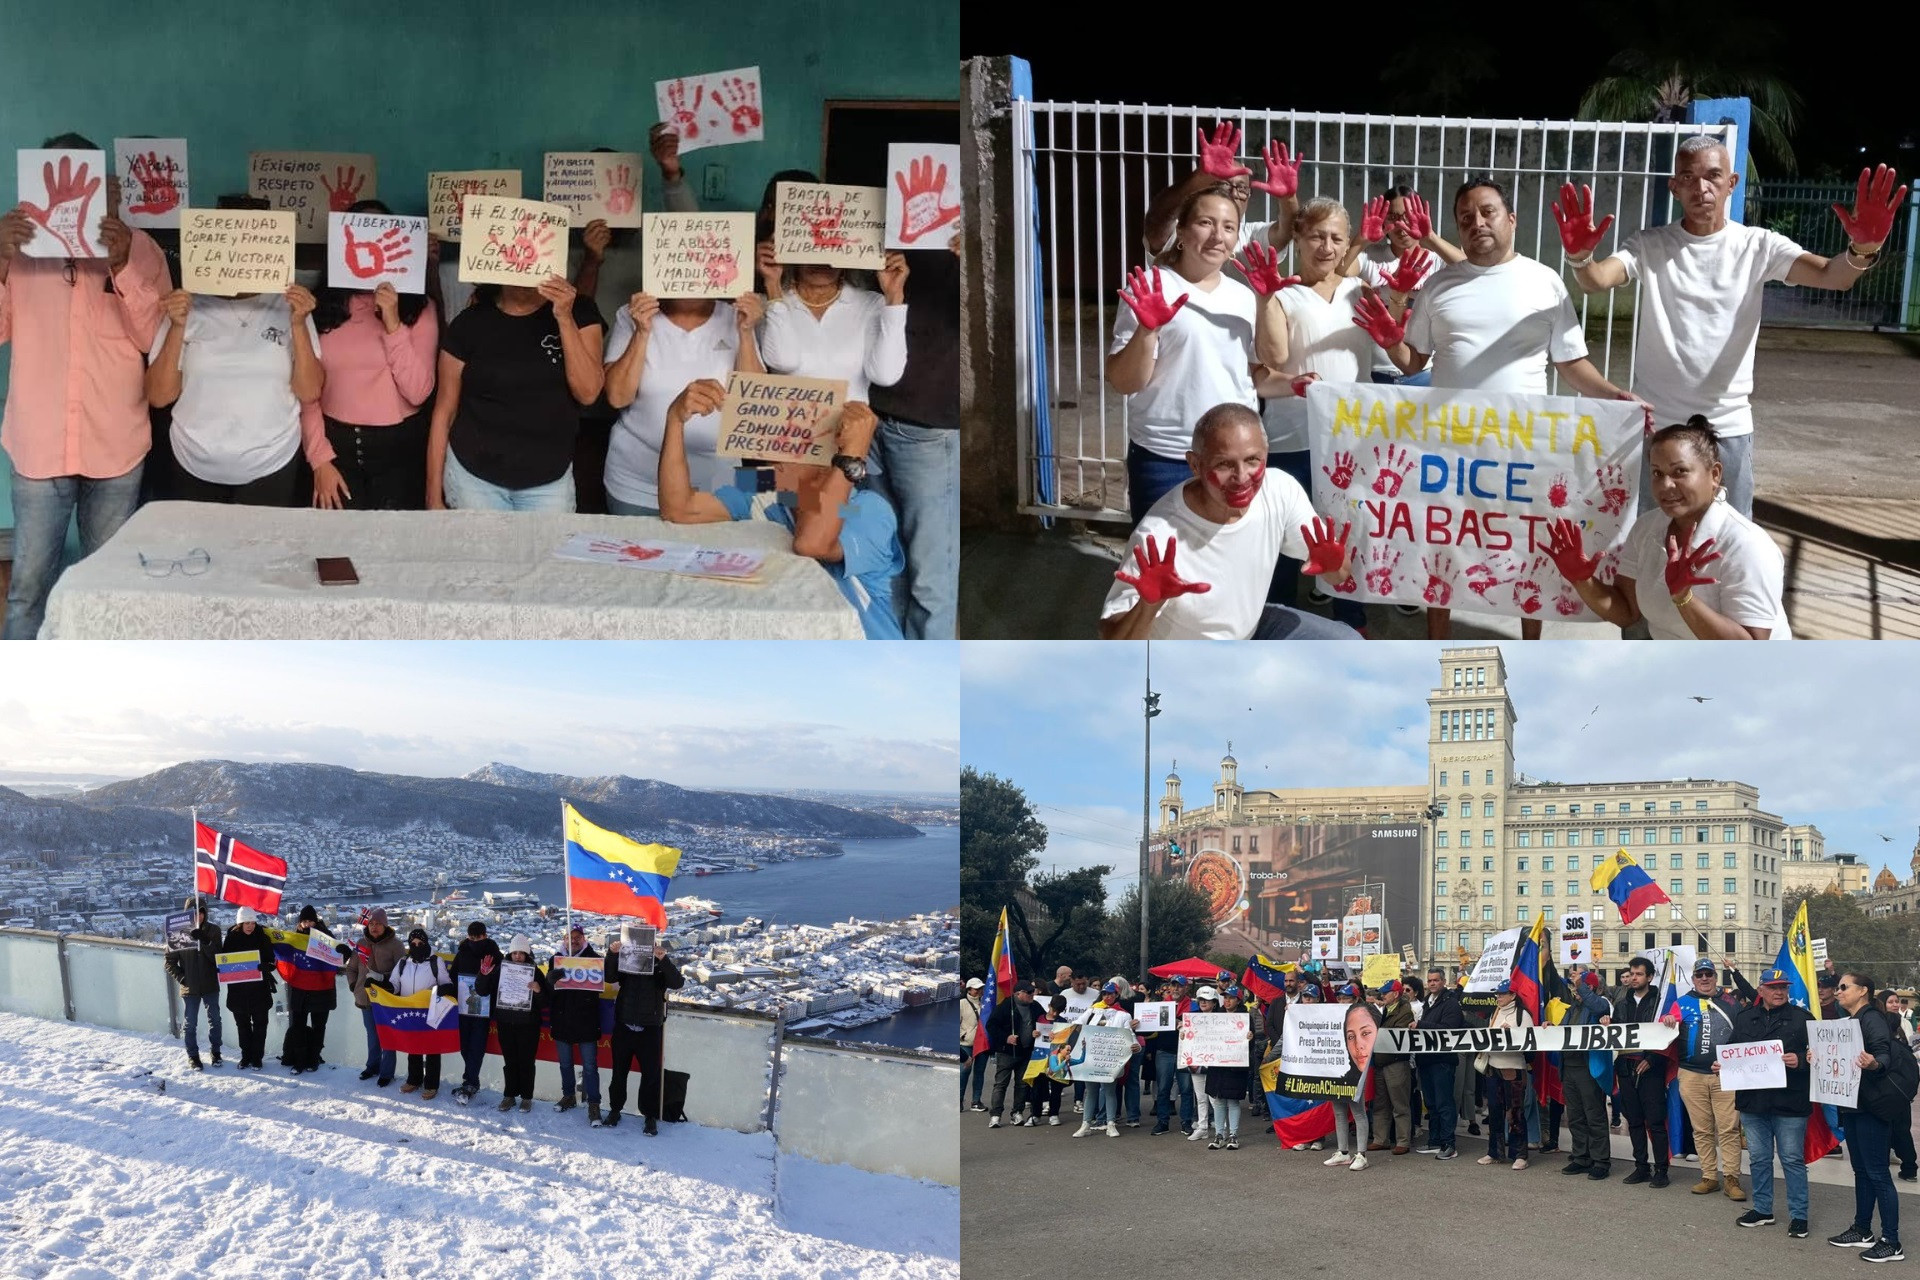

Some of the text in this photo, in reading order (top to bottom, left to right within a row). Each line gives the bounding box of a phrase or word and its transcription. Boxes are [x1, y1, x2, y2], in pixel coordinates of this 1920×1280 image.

[258, 178, 315, 191] RESPETO
[493, 178, 507, 189] LA
[279, 195, 307, 208] LOS
[787, 187, 862, 203] BASTA DE
[490, 205, 507, 220] EL
[511, 207, 526, 221] 10
[538, 211, 568, 228] ENERO
[782, 202, 857, 217] PERSECUCION
[194, 214, 278, 230] SERENIDAD
[650, 216, 731, 235] ¡YA BASTA
[839, 219, 887, 230] NUESTROS
[184, 230, 228, 244] CORAJE
[241, 232, 290, 245] FIRMEZA
[488, 224, 505, 236] ES
[481, 241, 535, 259] GANO
[656, 238, 731, 249] DE ABUSOS
[204, 249, 222, 262] LA
[228, 250, 286, 264] VICTORIA
[653, 252, 661, 266] Y
[195, 266, 211, 277] ES
[466, 256, 553, 275] VENEZUELA
[656, 266, 721, 280] ¡MADURO
[737, 401, 780, 417] GANO
[733, 420, 812, 440] EDMUNDO
[1332, 398, 1603, 456] MARHUANTA
[725, 434, 823, 457] PRESIDENTE
[1420, 454, 1536, 503] DICE
[1440, 755, 1489, 763] IBEROSTAR
[1371, 829, 1418, 838] SAMSUNG
[1250, 871, 1288, 879] troba-ho
[1565, 916, 1585, 931] SOS
[1272, 940, 1302, 949] Galaxy
[1499, 940, 1516, 952] Miguel
[558, 965, 603, 984] SOS
[1298, 1020, 1342, 1031] Chiquinquirá Leal
[1299, 1036, 1342, 1048] Presa Política
[1388, 1023, 1641, 1052] VENEZUELA LIBRE
[1721, 1043, 1783, 1060] CPI ACTUA YA
[1827, 1044, 1838, 1056] CPI
[1196, 1053, 1216, 1063] SOS
[1826, 1058, 1846, 1077] SOS
